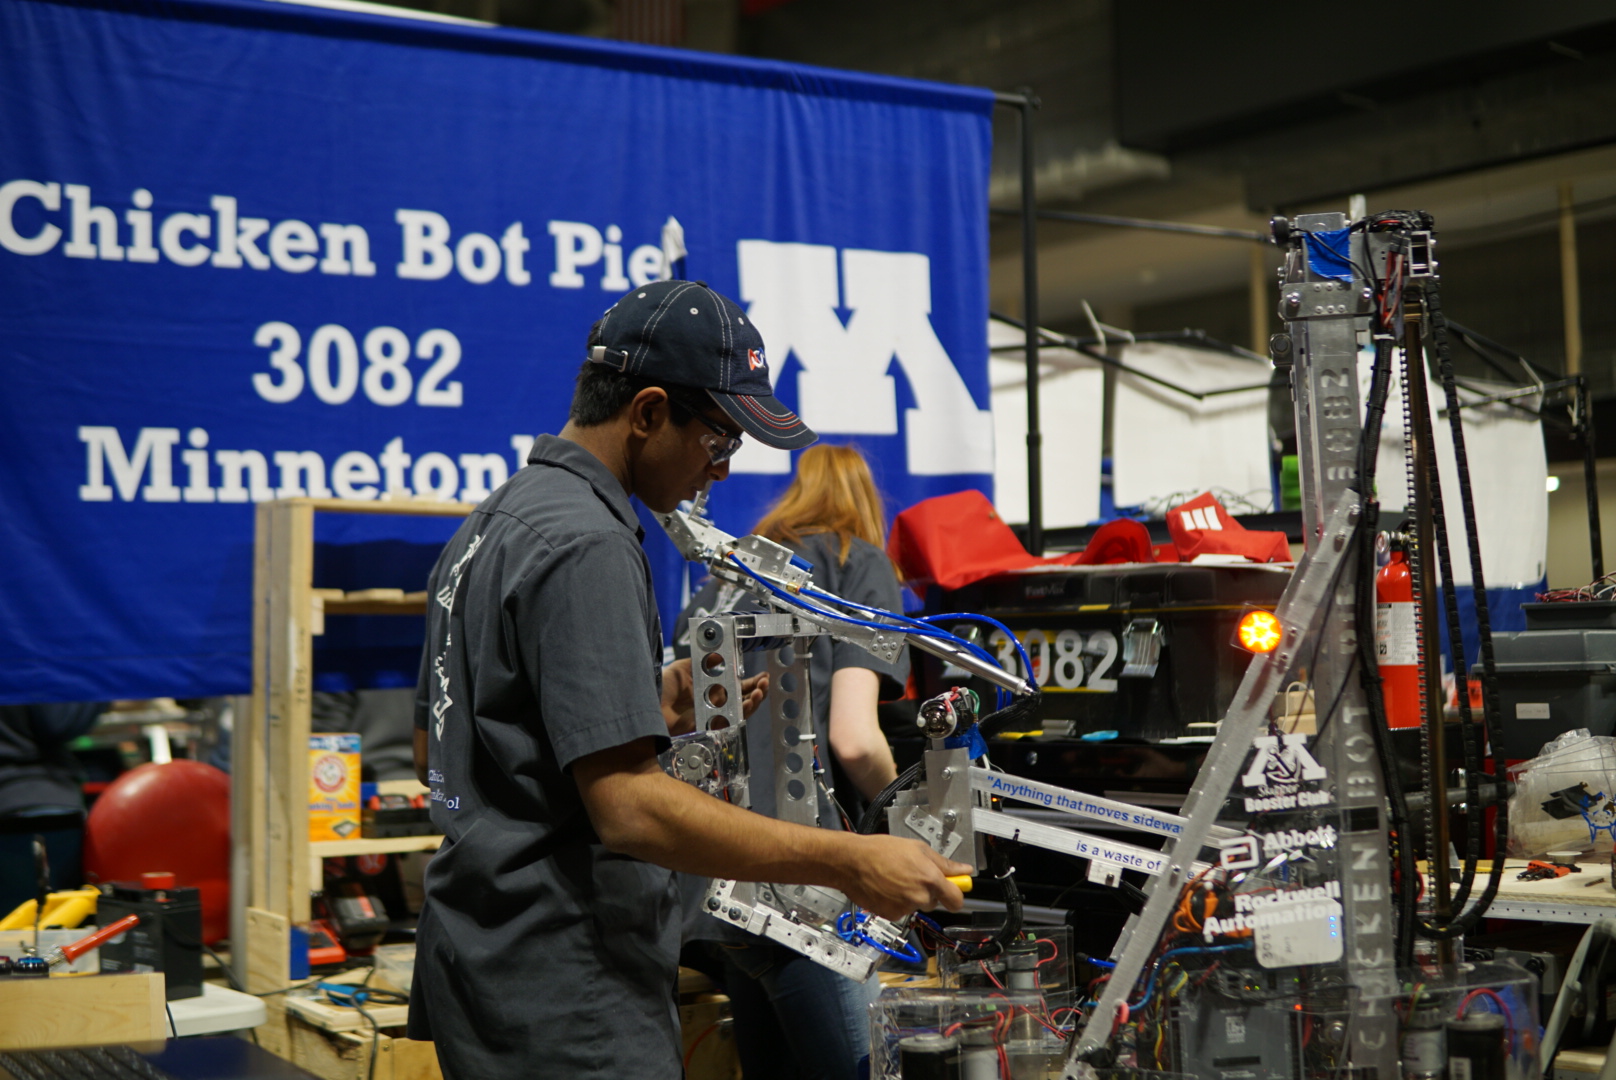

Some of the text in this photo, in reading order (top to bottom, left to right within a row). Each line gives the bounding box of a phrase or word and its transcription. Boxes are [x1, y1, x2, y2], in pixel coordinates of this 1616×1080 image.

[0, 179, 663, 291] Chicken Bot Pie
[252, 321, 463, 406] 3082
[1320, 367, 1356, 482] 3082
[988, 629, 1118, 692] 3082
[1342, 699, 1377, 798] BOT
[987, 776, 1053, 805] "Anything
[1056, 795, 1085, 811] that
[1085, 803, 1129, 821] moves
[1244, 789, 1331, 812] Booster Club
[1076, 839, 1161, 871] is a waste of
[1263, 824, 1337, 850] Abbott
[1202, 900, 1343, 935] Automation
[1234, 880, 1341, 912] Rockwell
